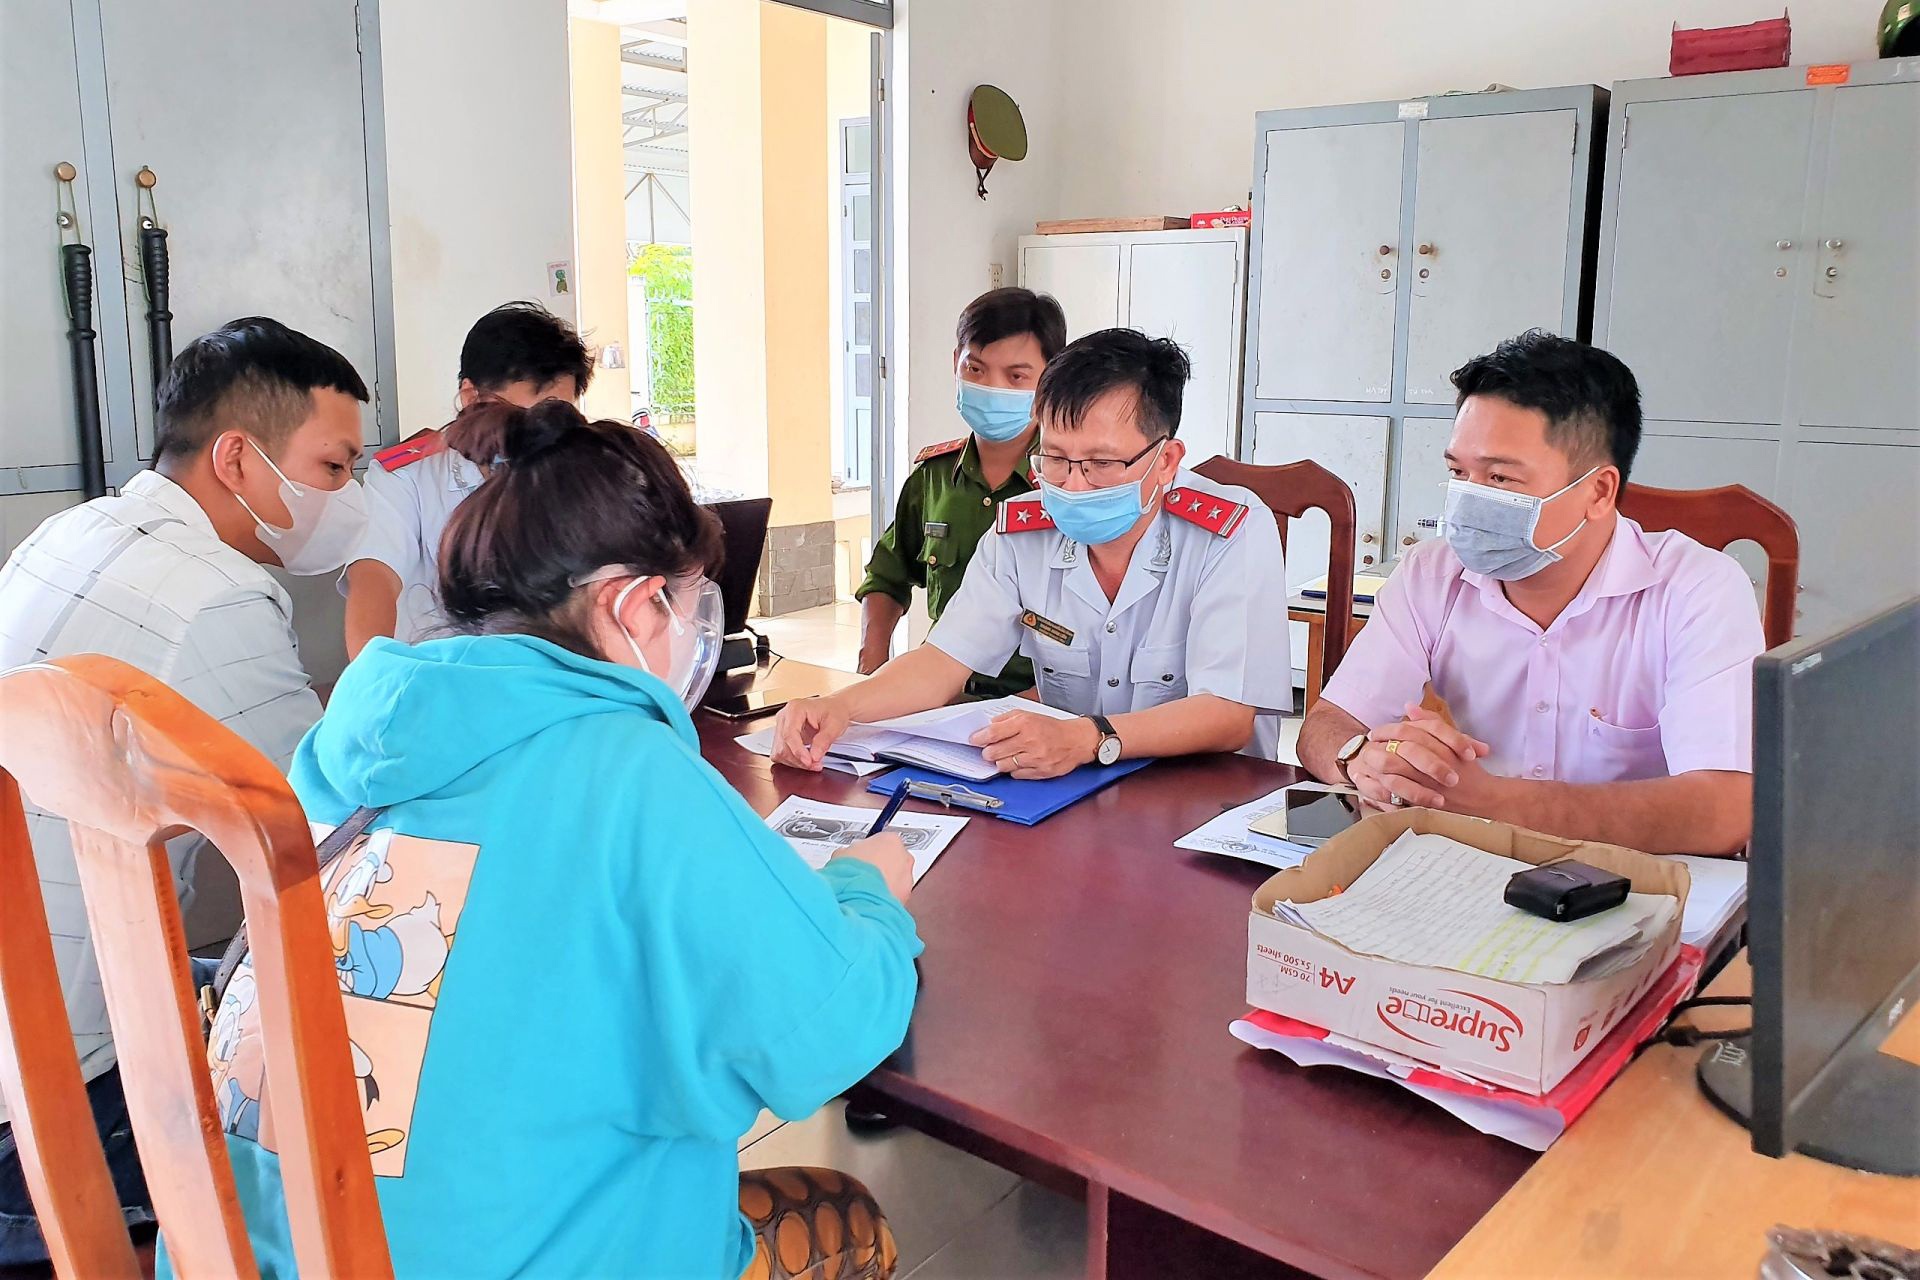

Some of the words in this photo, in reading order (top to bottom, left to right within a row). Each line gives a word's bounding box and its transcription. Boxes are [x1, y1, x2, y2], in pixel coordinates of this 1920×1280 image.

[1257, 944, 1281, 959] sheets
[1280, 965, 1299, 978] GSM
[1300, 973, 1310, 983] 70
[1319, 967, 1356, 995] A4
[1389, 986, 1409, 997] needs
[1410, 991, 1427, 1002] your
[1428, 996, 1438, 1006] for
[1440, 999, 1471, 1014] Excellent
